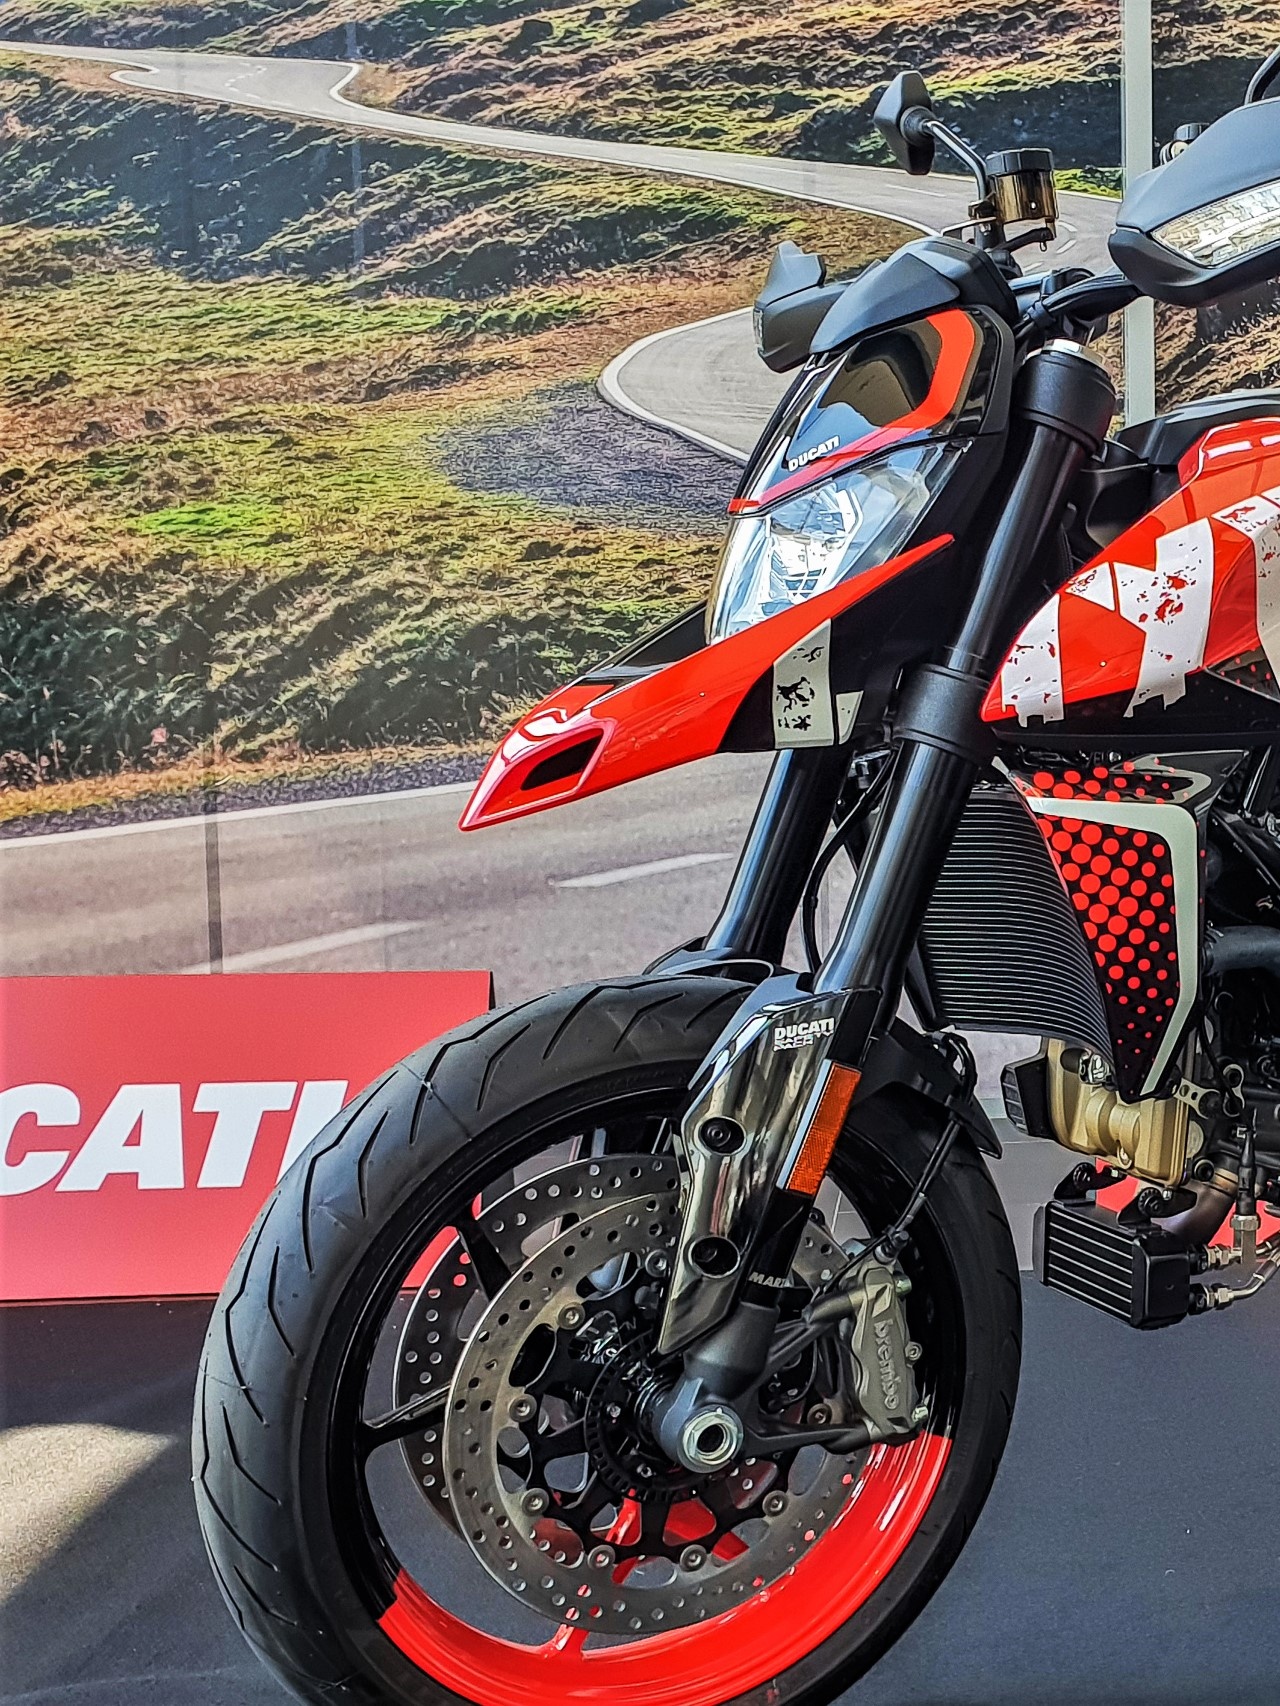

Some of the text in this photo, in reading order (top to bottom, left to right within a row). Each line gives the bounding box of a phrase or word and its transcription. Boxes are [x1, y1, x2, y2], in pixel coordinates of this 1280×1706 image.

[788, 435, 840, 472] DUCATI
[774, 1017, 835, 1038] DUCATI
[874, 1318, 901, 1409] brembo
